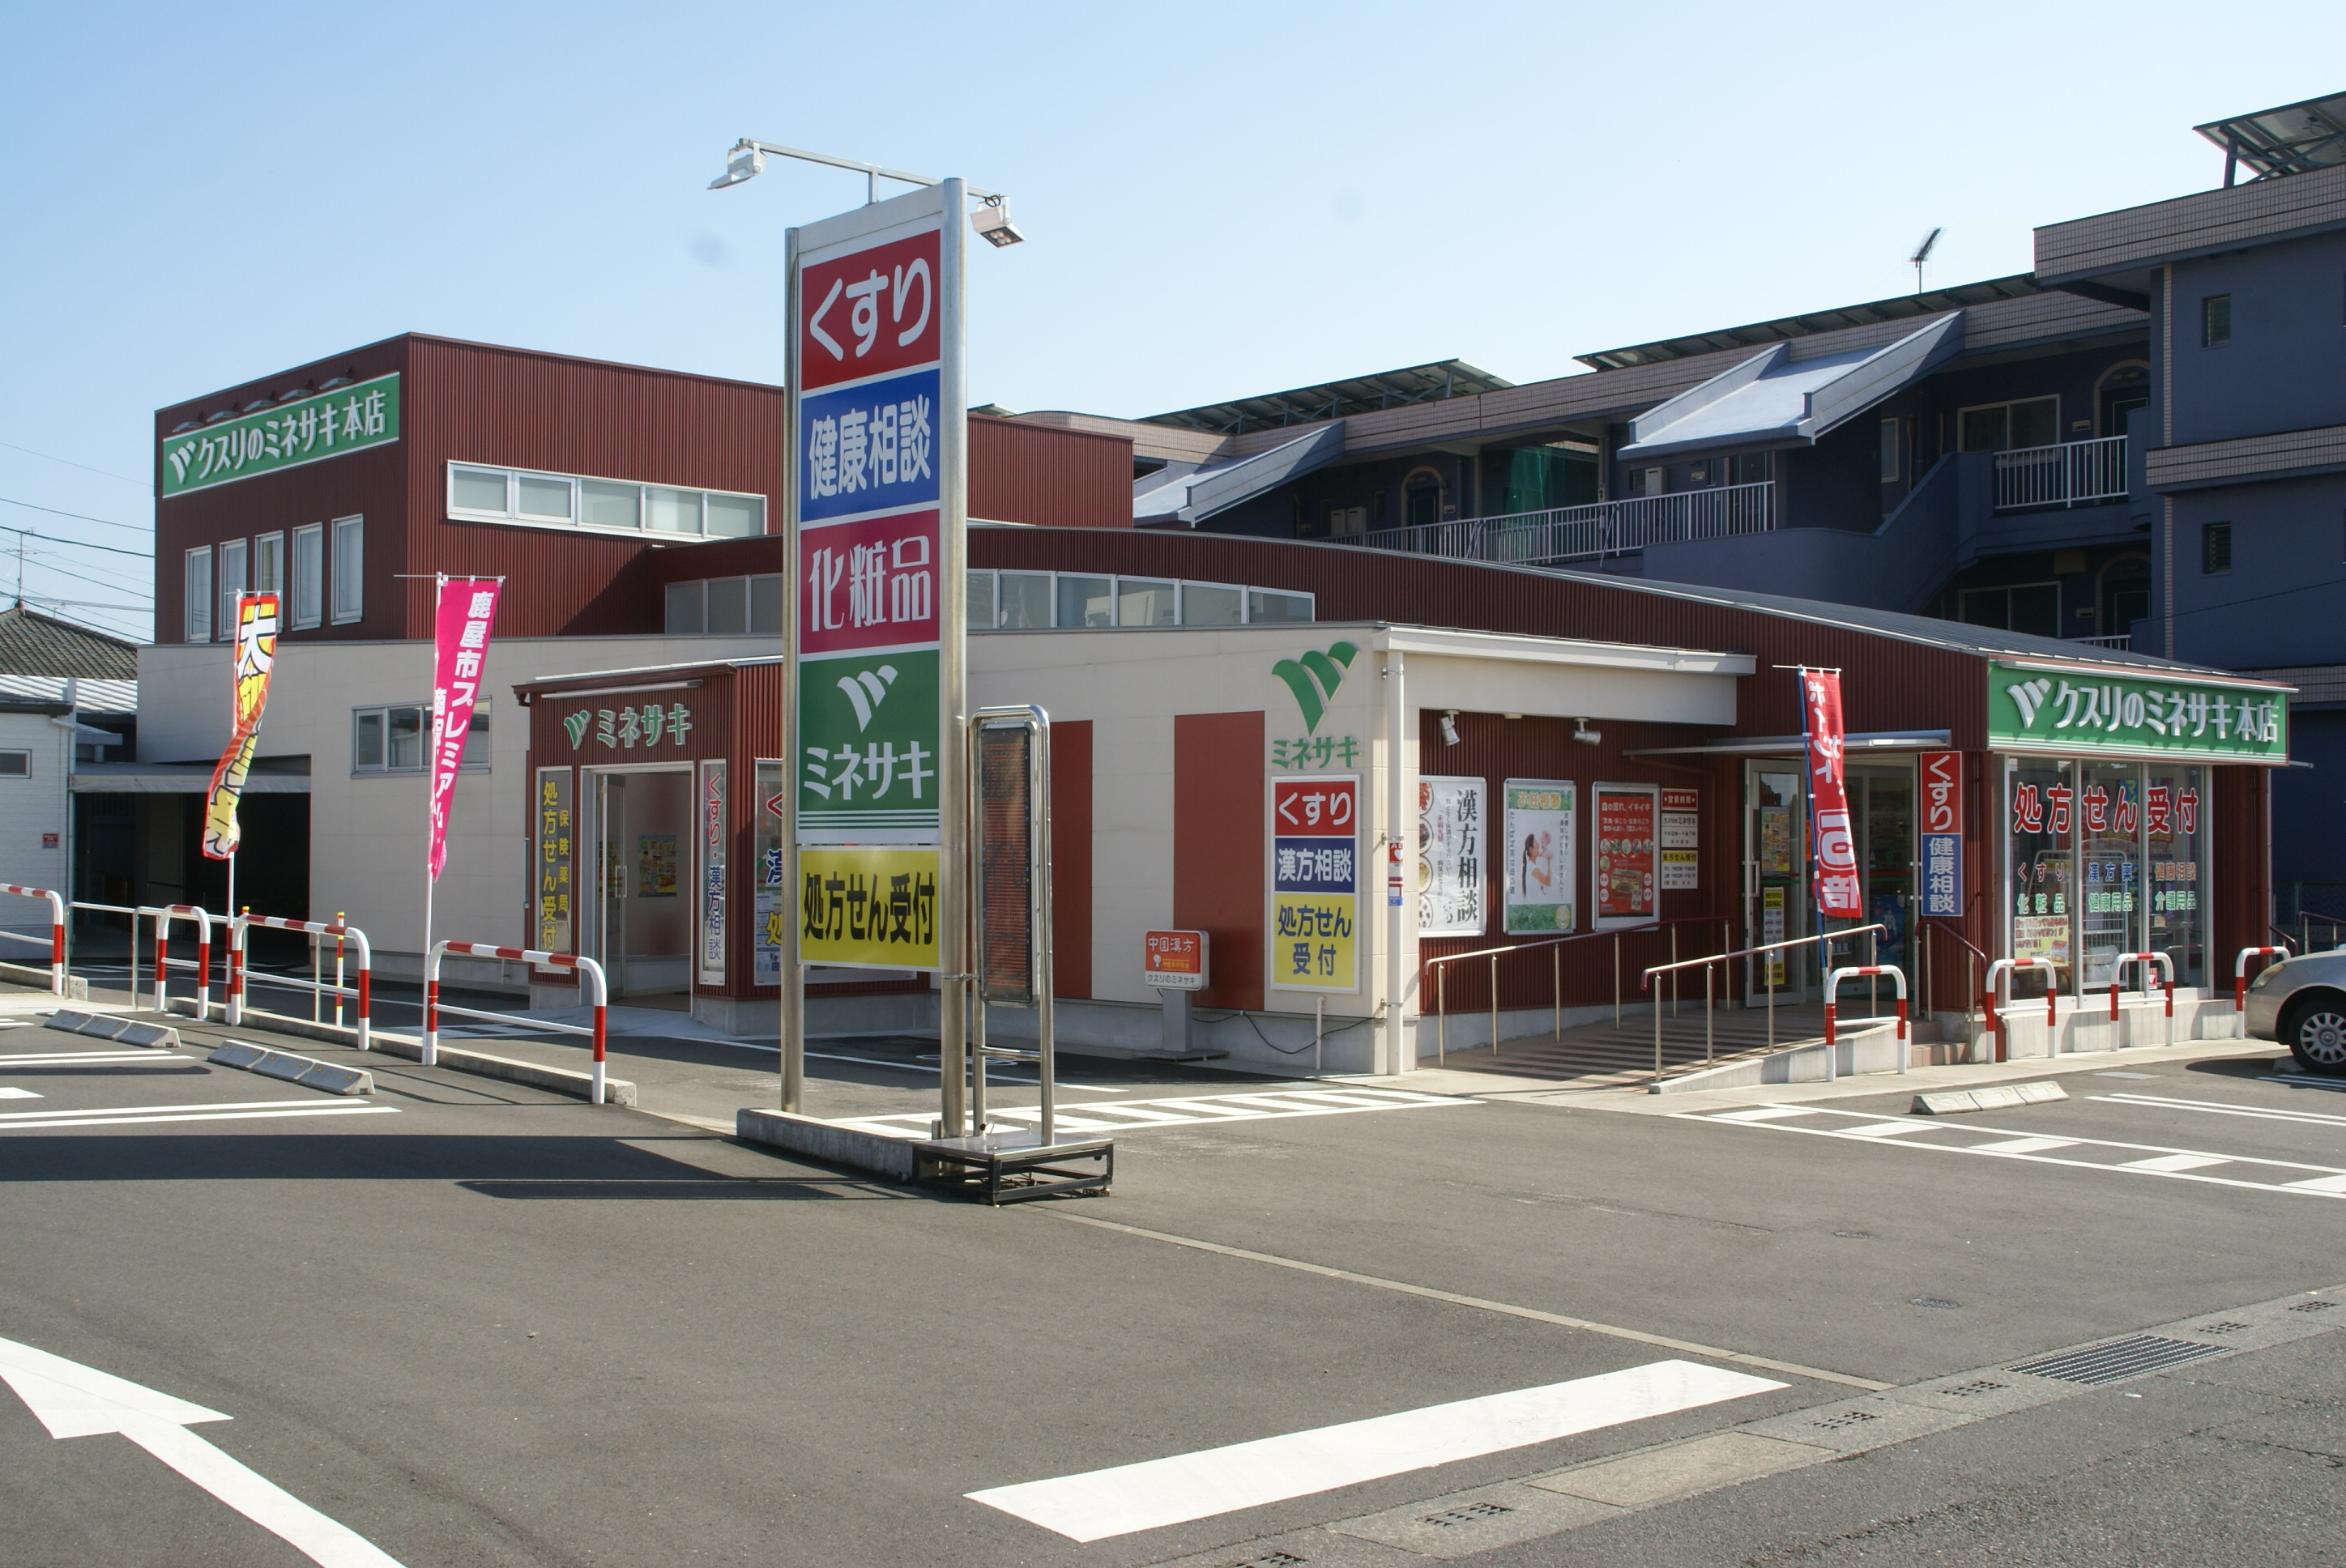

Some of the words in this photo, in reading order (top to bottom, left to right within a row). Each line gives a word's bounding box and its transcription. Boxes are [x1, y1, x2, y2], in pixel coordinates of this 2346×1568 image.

[810, 258, 932, 361] くすり
[198, 390, 386, 479] クスリのミネサキ本店
[809, 393, 931, 501] 健康相談
[808, 535, 931, 632] 化粧品
[597, 703, 693, 748] ミネサキ
[2053, 680, 2279, 743] クスリのミネサキ本店
[804, 740, 934, 800] ミネサキ
[1272, 736, 1361, 769] ミネサキ
[1279, 792, 1351, 825] くすり
[1929, 755, 1954, 832] くすり
[2014, 782, 2199, 834] 処方せん受付
[542, 781, 558, 951] 処方せん受付
[559, 809, 569, 913] 保険薬局
[1278, 848, 1351, 882] 漢方相談
[1457, 789, 1478, 923] 漢方相談
[1929, 837, 1955, 913] 健康相談
[2018, 862, 2065, 882] くすり
[2088, 862, 2133, 882] 漢方薬
[2155, 862, 2196, 881] 健康相談
[804, 871, 935, 945] 処方せん受付
[1278, 905, 1351, 938] 処方せん
[2017, 893, 2065, 914] 化粧品
[2088, 892, 2132, 912] 健康用品
[2155, 891, 2196, 911] 介護用品
[1148, 935, 1194, 953] 中国漢方
[1293, 944, 1337, 976] 受付
[1147, 974, 1196, 986] クスリのミネサキ
